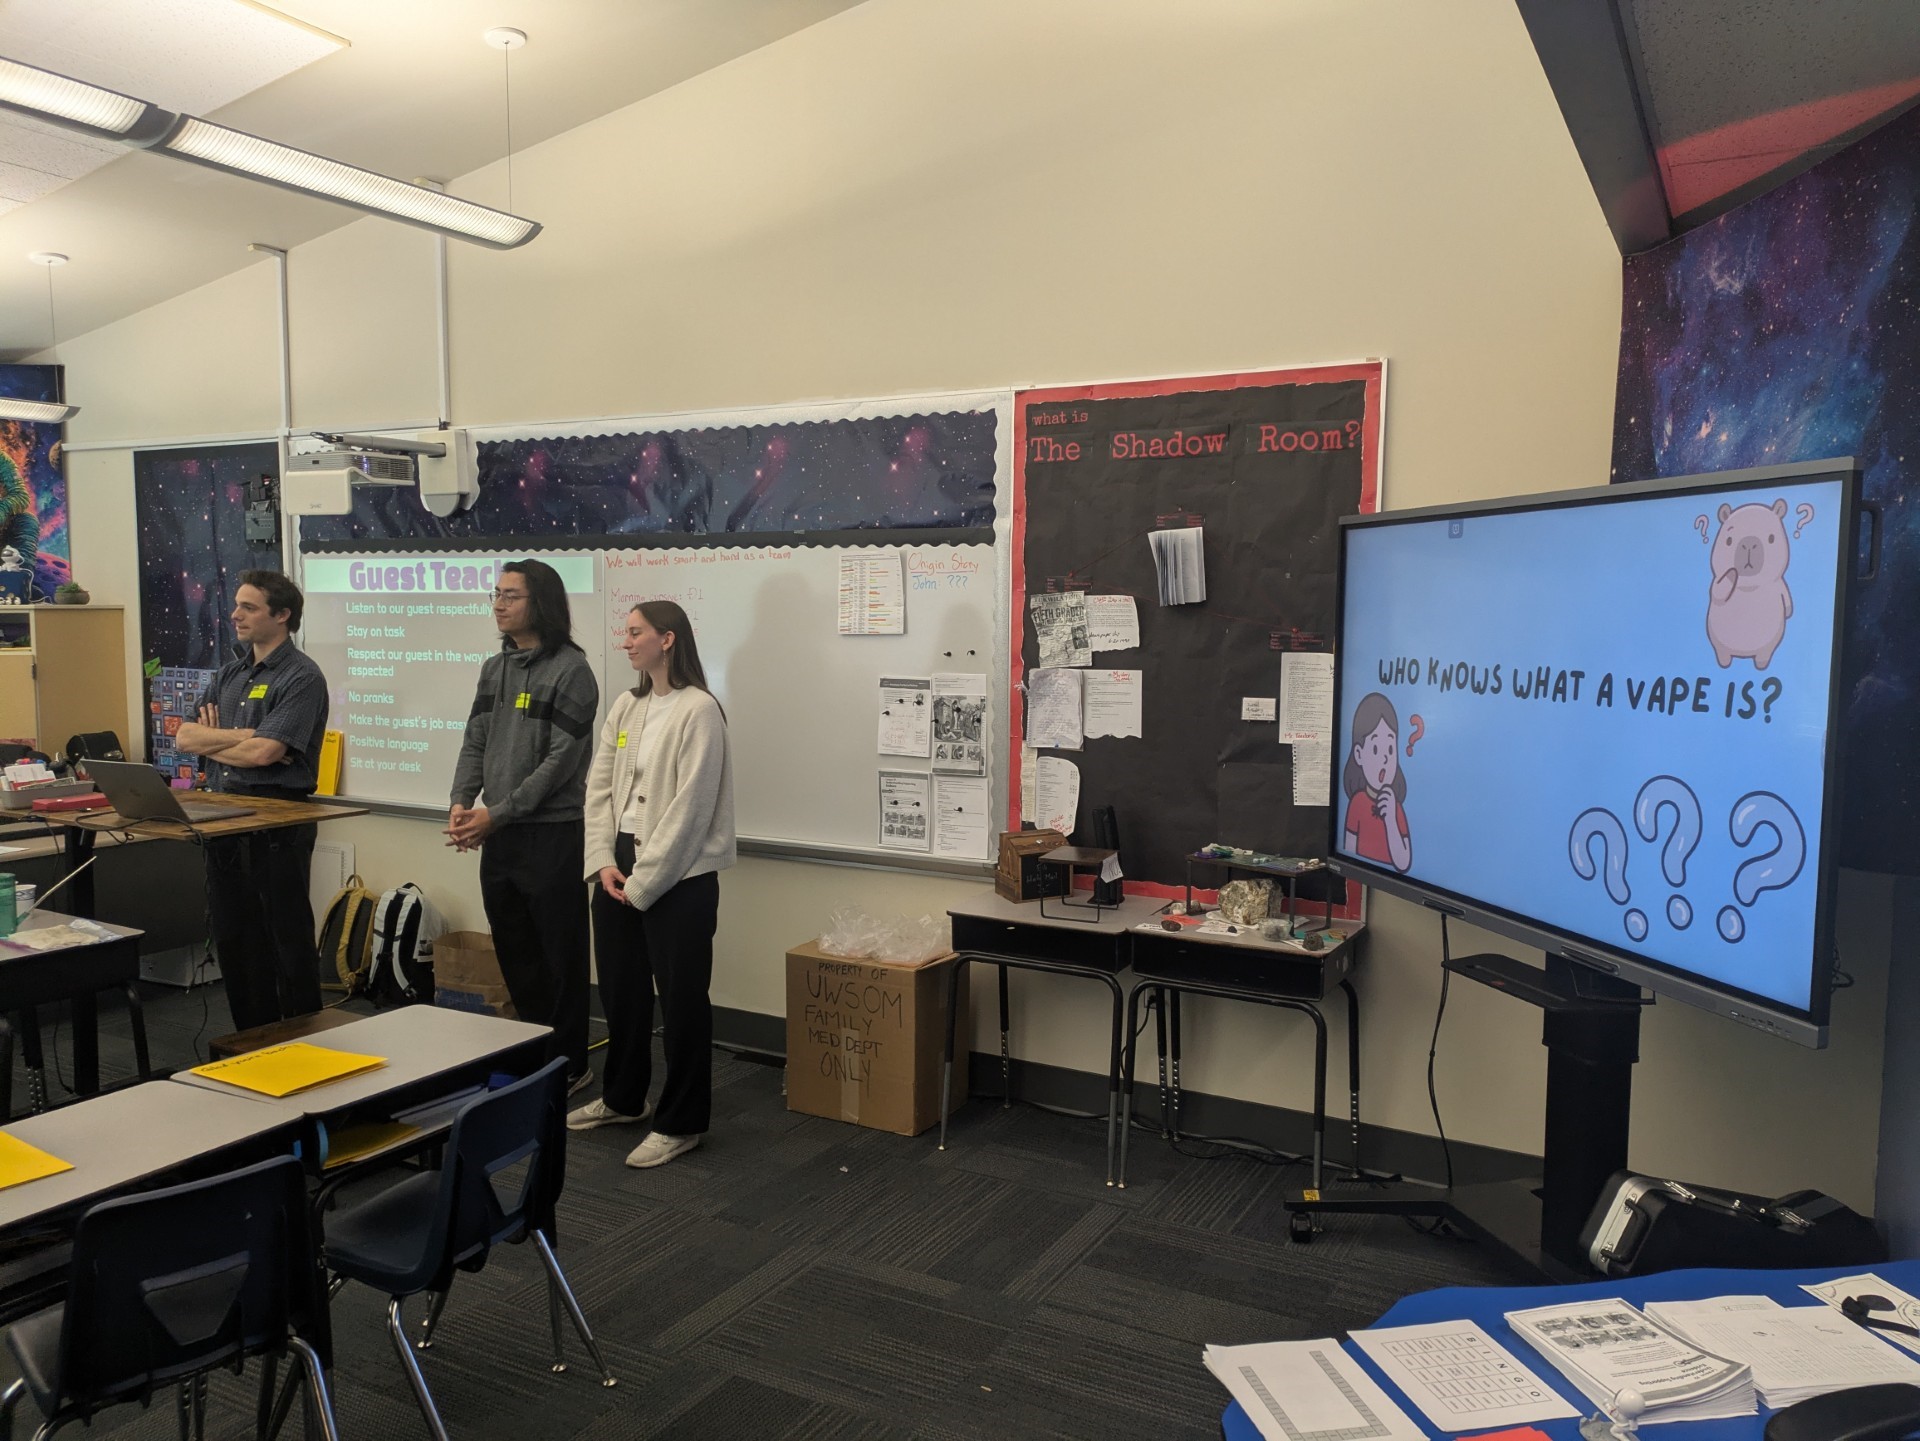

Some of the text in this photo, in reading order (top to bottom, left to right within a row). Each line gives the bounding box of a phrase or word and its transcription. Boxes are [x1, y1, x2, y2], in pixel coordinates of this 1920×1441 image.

[1032, 410, 1089, 426] what is
[1030, 420, 1362, 462] The Shadow Room?
[605, 556, 623, 568] We
[626, 554, 642, 567] will
[646, 555, 669, 566] work
[673, 552, 698, 563] smart
[701, 552, 716, 563] and
[720, 551, 740, 562] hard
[744, 552, 755, 560] as
[768, 549, 792, 560] team
[908, 552, 979, 576] Origin Story
[349, 561, 427, 591] Guest
[346, 603, 492, 617] Listen to our guest respectfully
[346, 625, 405, 638] Stay on task
[347, 648, 385, 662] Respect
[388, 651, 403, 660] our
[405, 651, 432, 662] guest
[434, 651, 443, 661] in
[445, 651, 461, 662] the
[464, 654, 483, 664] way
[348, 665, 394, 678] respected
[349, 691, 394, 705] No pranks
[1378, 656, 1783, 724] WHO KNOWS WHAT A VAPE IS?
[349, 715, 372, 726] Make
[375, 717, 390, 727] the
[393, 717, 426, 730] guest's
[429, 718, 444, 731] job
[350, 736, 385, 748] Positive
[387, 738, 428, 752] language
[350, 758, 421, 773] Sit at your desk
[818, 962, 889, 981] PROPERTY OF
[806, 969, 902, 1029] UWSOM
[805, 1004, 873, 1036] FAMILY
[808, 1027, 883, 1058] MED DEPT
[820, 1051, 871, 1097] ONLY
